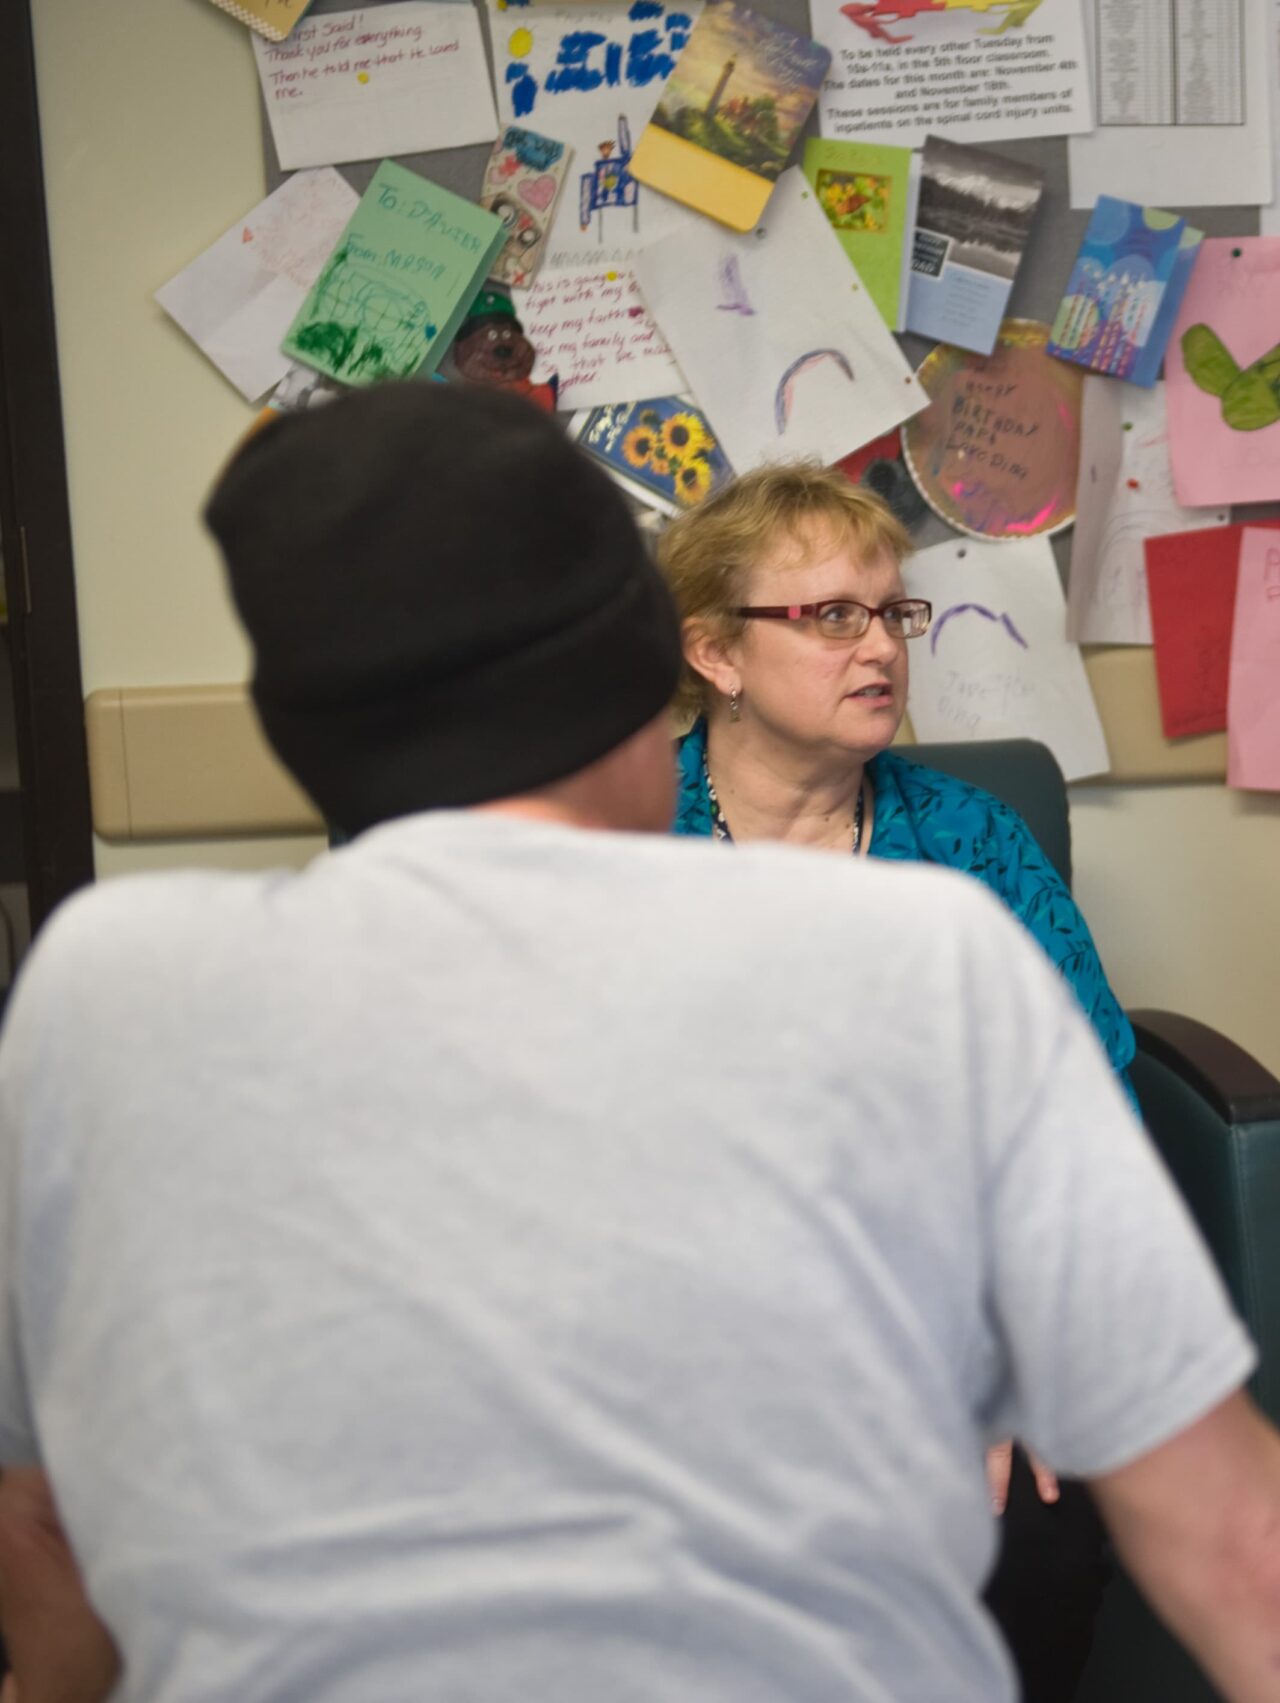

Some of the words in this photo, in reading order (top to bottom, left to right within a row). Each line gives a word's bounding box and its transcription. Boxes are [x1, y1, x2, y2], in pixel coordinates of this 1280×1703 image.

[264, 46, 304, 63] Thank
[307, 42, 331, 62] you
[332, 37, 352, 53] for
[840, 48, 856, 60] To
[858, 49, 873, 59] be
[876, 46, 902, 58] held
[905, 43, 936, 57] every
[940, 41, 971, 53] other
[973, 36, 1023, 51] Tuesday
[1025, 33, 1054, 45] from
[352, 57, 371, 73] me
[375, 50, 404, 69] that
[899, 60, 910, 71] in
[913, 57, 930, 69] the
[933, 55, 951, 67] 5th
[954, 53, 982, 66] floor
[986, 50, 1050, 64] classroom.
[823, 79, 845, 92] The
[848, 76, 880, 90] dates
[883, 75, 901, 87] for
[903, 72, 925, 84] this
[929, 69, 966, 83] month
[995, 61, 1056, 77] November
[1059, 59, 1078, 71] 4th
[274, 87, 304, 101] me.
[827, 107, 864, 120] These
[866, 104, 920, 117] sessions
[923, 101, 941, 112] are
[943, 98, 961, 110] for
[963, 95, 999, 110] family
[1003, 90, 1058, 105] members
[1061, 88, 1074, 100] of
[895, 88, 918, 99] and
[920, 83, 980, 98] November
[834, 119, 893, 134] inpatients
[896, 117, 911, 128] on
[914, 114, 934, 127] the
[937, 111, 972, 127] spinal
[976, 109, 1002, 122] cord
[1005, 106, 1039, 121] injury
[1042, 103, 1075, 116] units.
